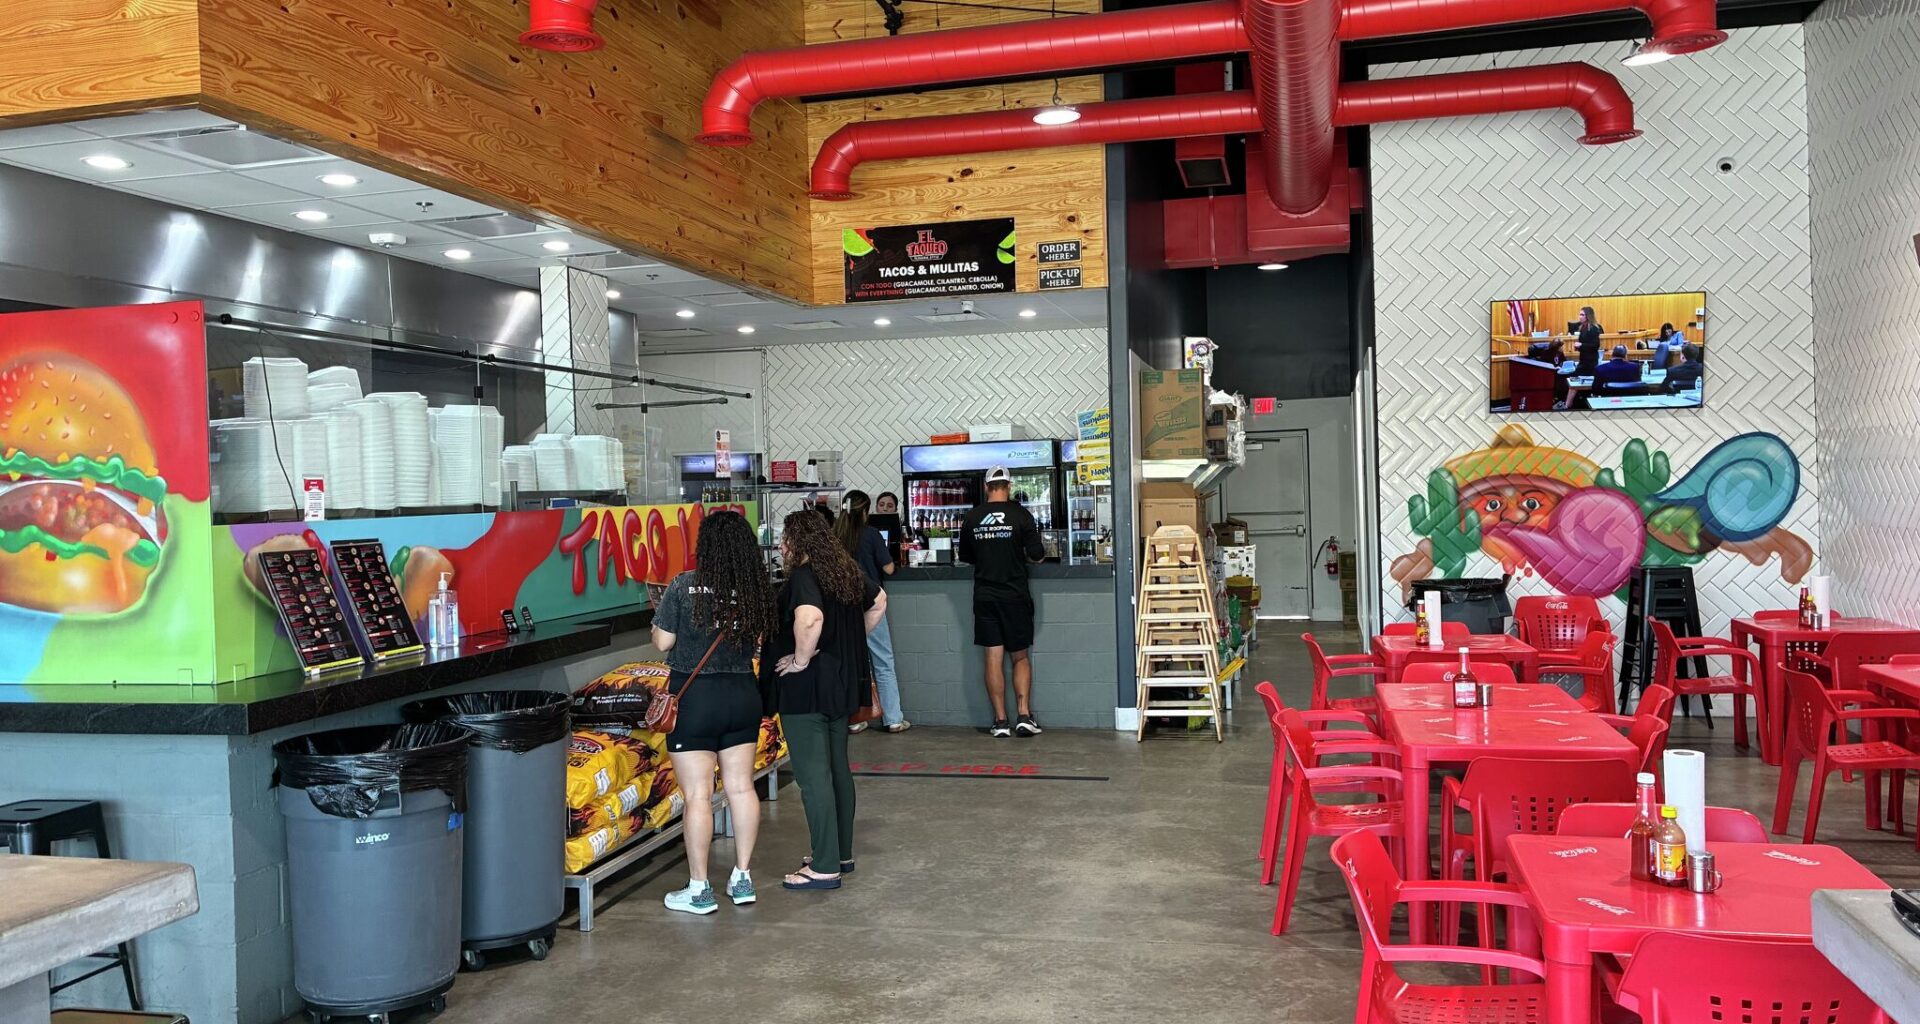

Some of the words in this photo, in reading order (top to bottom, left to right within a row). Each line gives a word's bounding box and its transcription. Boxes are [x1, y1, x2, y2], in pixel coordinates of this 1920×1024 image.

[917, 230, 935, 243] EL
[906, 241, 948, 256] TAQUEO
[1041, 243, 1077, 253] ORDER
[1048, 253, 1070, 261] HERE
[879, 266, 915, 278] TACOS
[917, 265, 927, 275] &
[929, 262, 979, 274] MULITAS
[1040, 269, 1080, 279] PICK-UP
[1049, 279, 1071, 287] HERE
[870, 289, 904, 297] EVERYTHING
[559, 507, 669, 597] TACO
